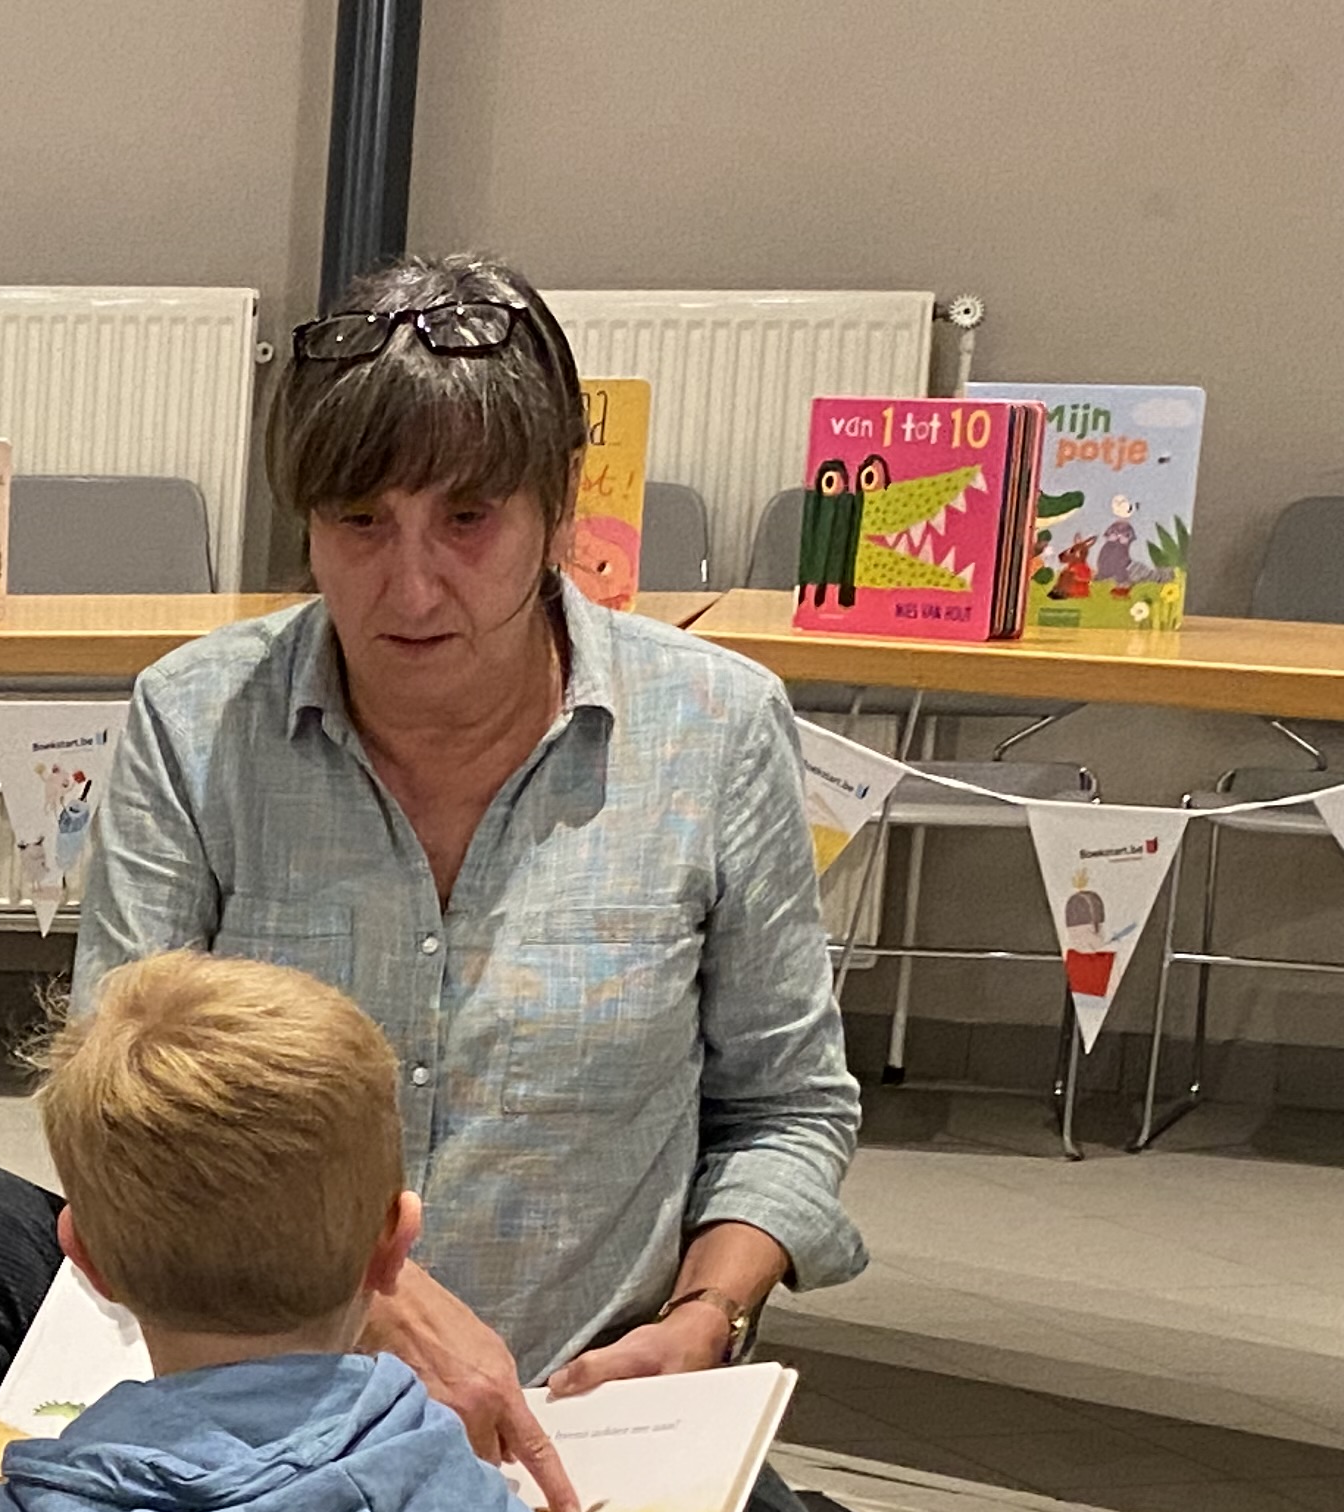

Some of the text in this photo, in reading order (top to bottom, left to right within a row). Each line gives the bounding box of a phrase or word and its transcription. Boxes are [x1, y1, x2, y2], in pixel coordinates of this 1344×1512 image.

[831, 406, 991, 449] van 1 tot 10
[1046, 403, 1111, 439] Mijn
[1055, 436, 1149, 472] potje
